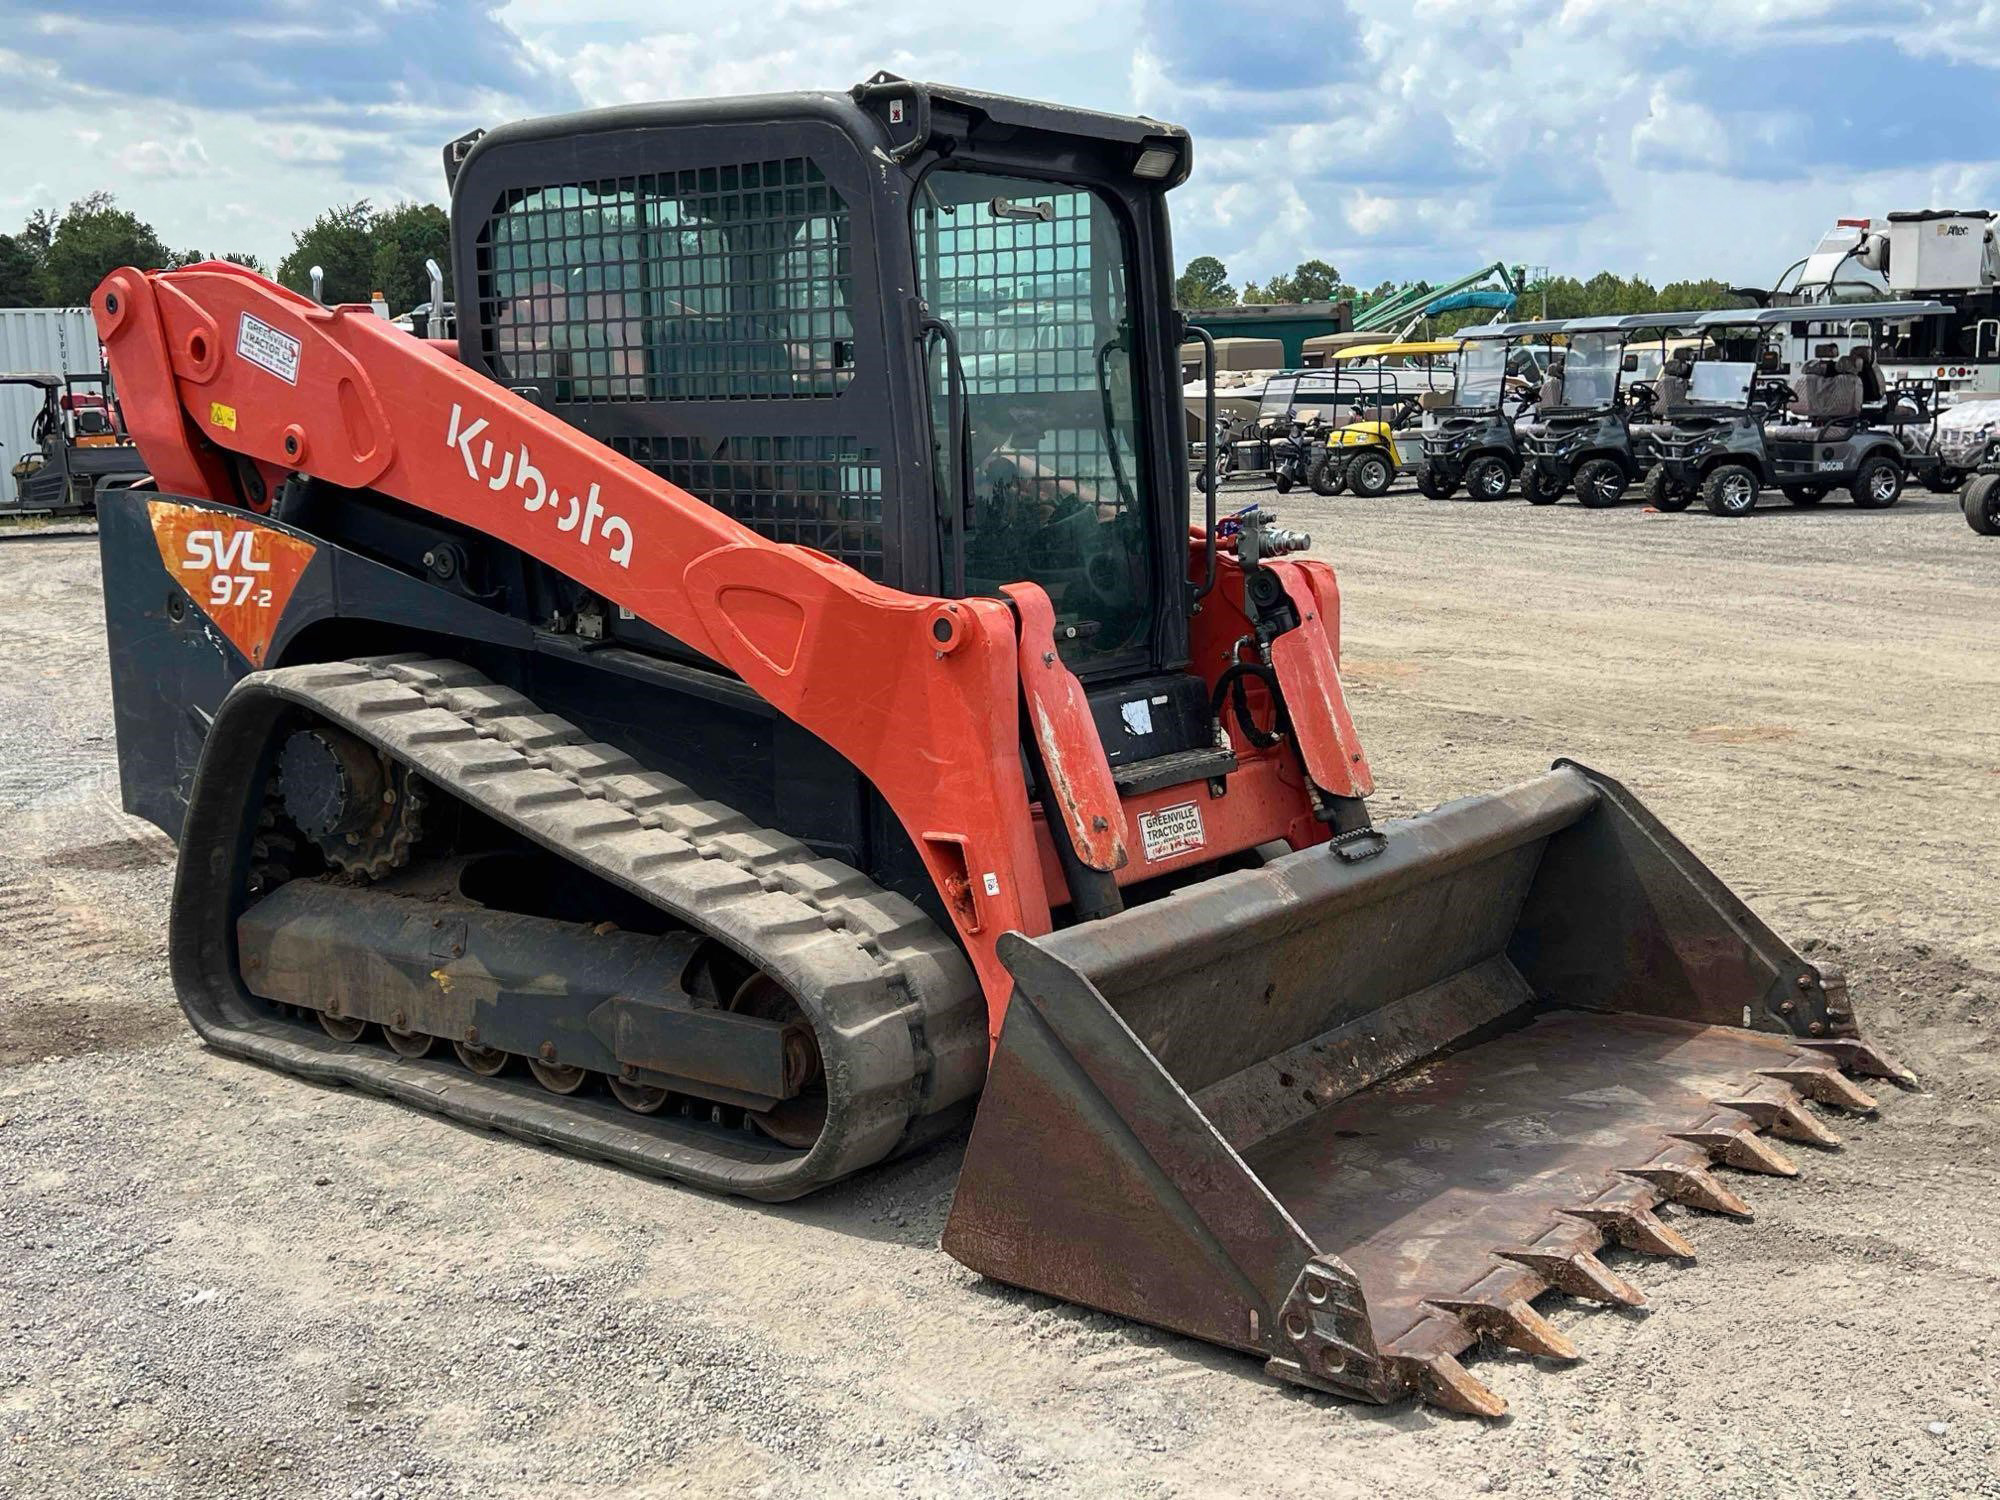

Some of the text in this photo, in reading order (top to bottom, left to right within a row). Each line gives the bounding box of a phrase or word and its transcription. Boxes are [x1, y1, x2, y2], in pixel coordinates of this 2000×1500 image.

[246, 331, 280, 356] TRACTOR
[247, 321, 295, 350] GREENVILLE
[447, 403, 634, 569] Kubota
[182, 530, 271, 571] SVL
[209, 574, 273, 607] 97-2
[1147, 808, 1194, 829] GREENVILLE
[1147, 819, 1198, 841] TRACTOR CO
